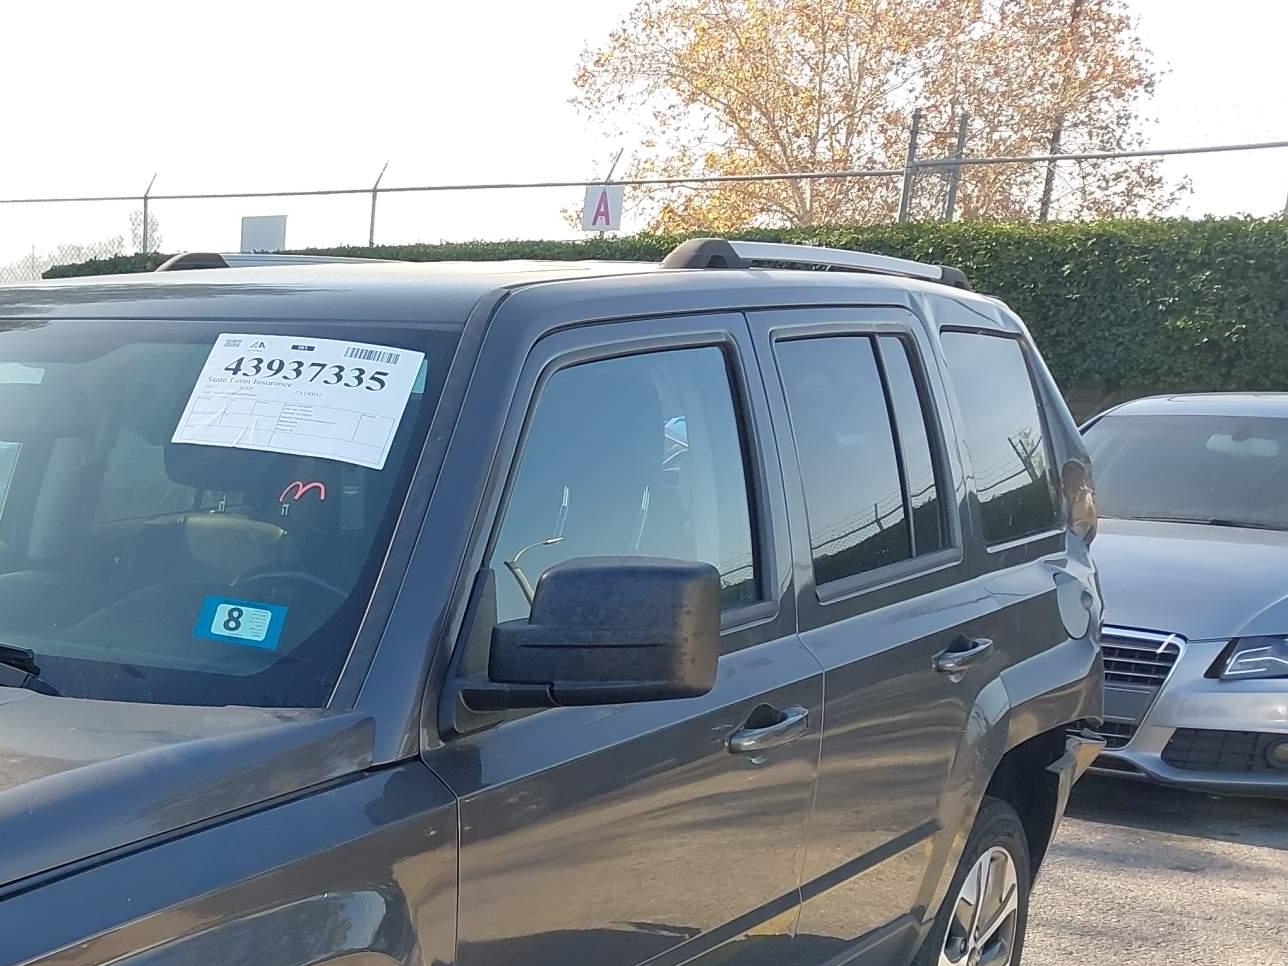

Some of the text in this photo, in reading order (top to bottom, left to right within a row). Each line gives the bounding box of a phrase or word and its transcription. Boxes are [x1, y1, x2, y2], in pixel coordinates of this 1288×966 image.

[592, 189, 610, 225] A
[208, 375, 293, 388] State Farm Insurance
[224, 356, 390, 392] 43937335
[223, 607, 243, 631] 8
